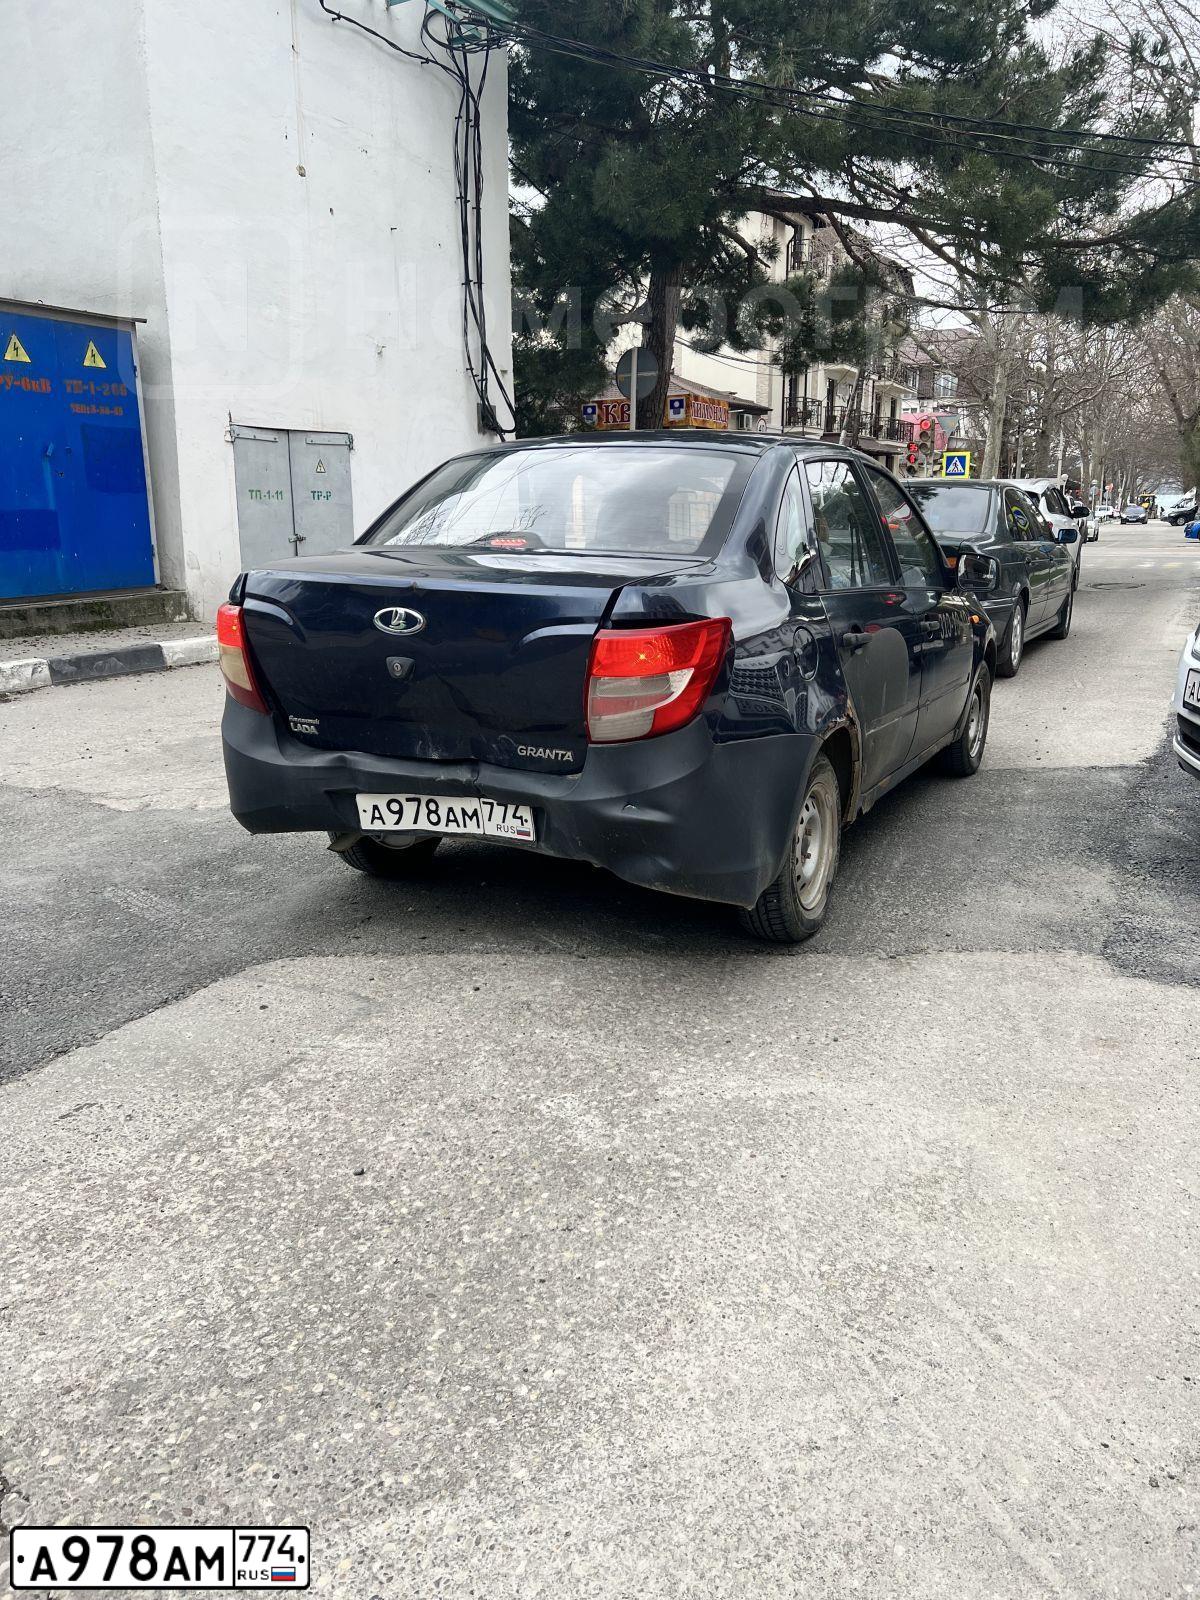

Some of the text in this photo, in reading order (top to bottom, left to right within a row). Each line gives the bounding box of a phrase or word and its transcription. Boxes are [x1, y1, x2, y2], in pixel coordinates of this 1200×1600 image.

[290, 722, 319, 735] LADA
[517, 745, 574, 762] GRANTA
[482, 801, 523, 826] 774
[496, 823, 516, 835] RUS
